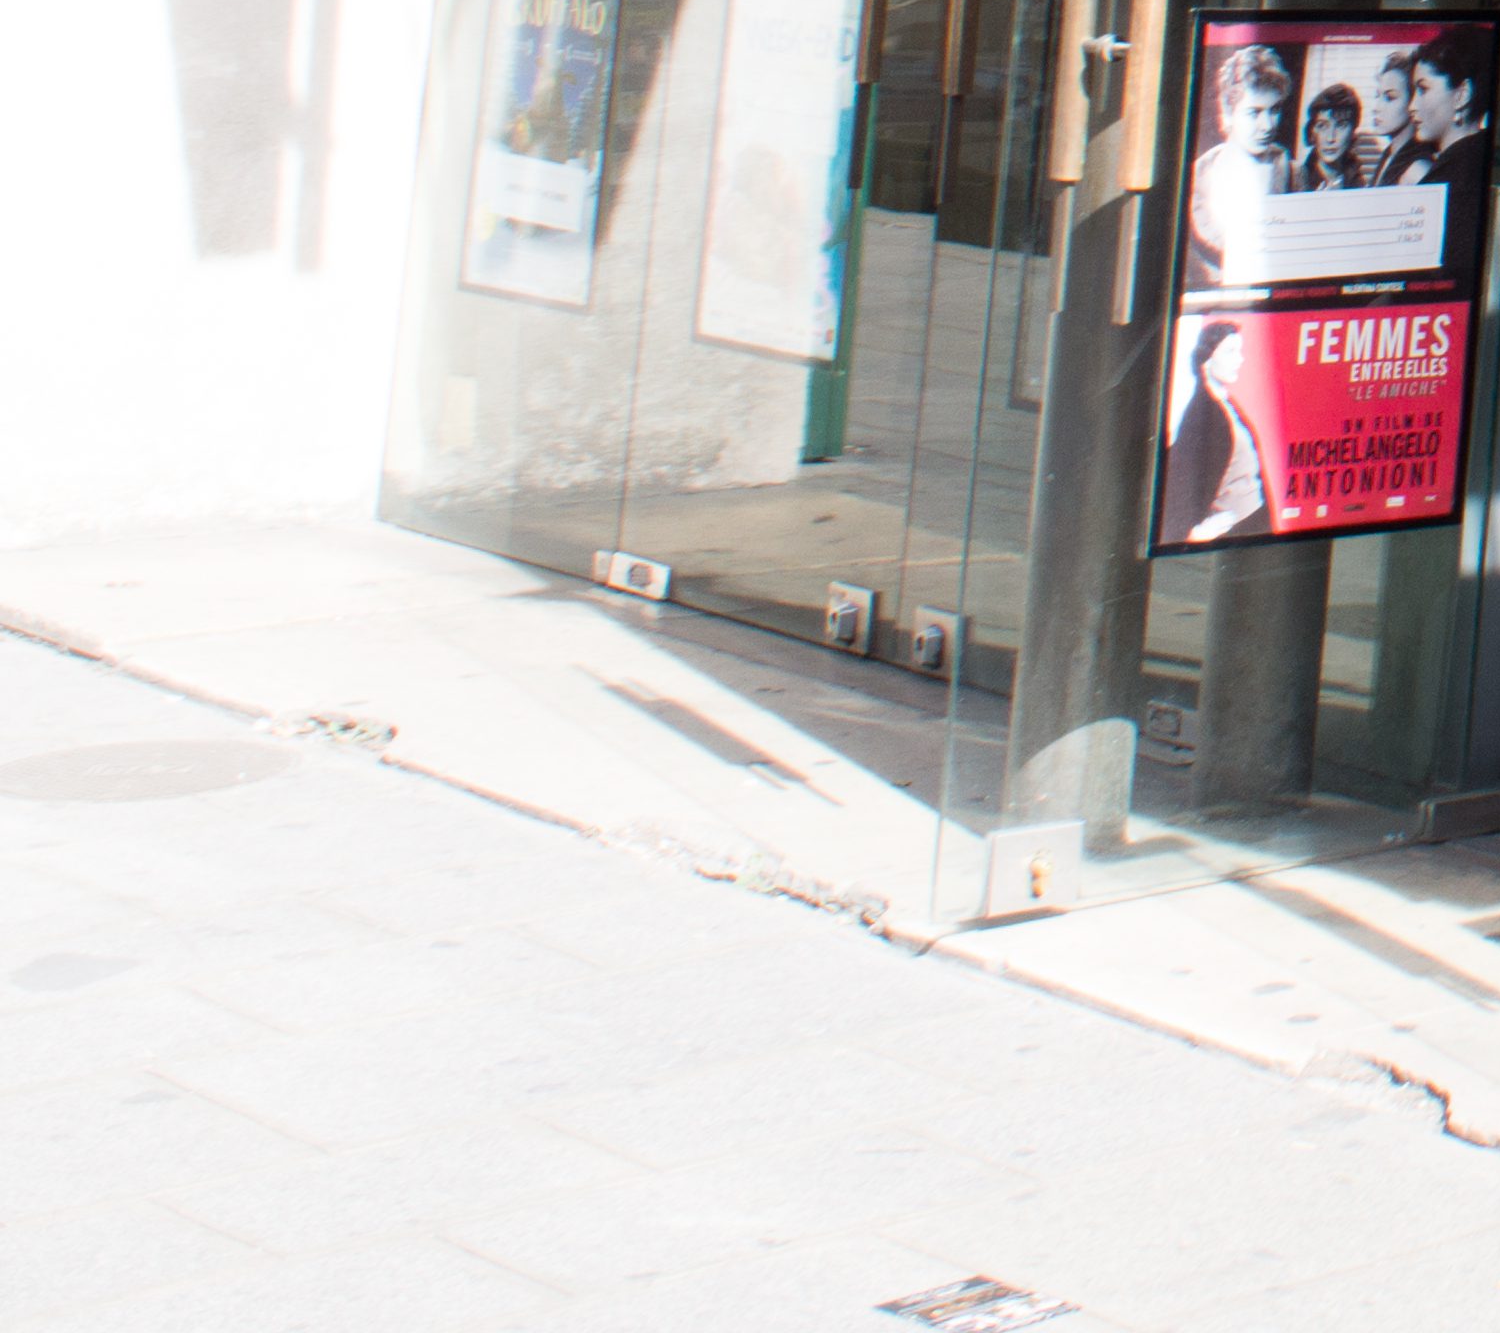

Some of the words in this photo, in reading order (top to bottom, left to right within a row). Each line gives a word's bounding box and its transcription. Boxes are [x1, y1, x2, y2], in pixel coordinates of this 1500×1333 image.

[1296, 314, 1452, 365] FEMMES
[1349, 361, 1404, 383] ENTRE
[1404, 358, 1449, 379] ELLES
[1287, 431, 1441, 468] MICHELANGELO
[1284, 460, 1437, 501] ANTONIONI
